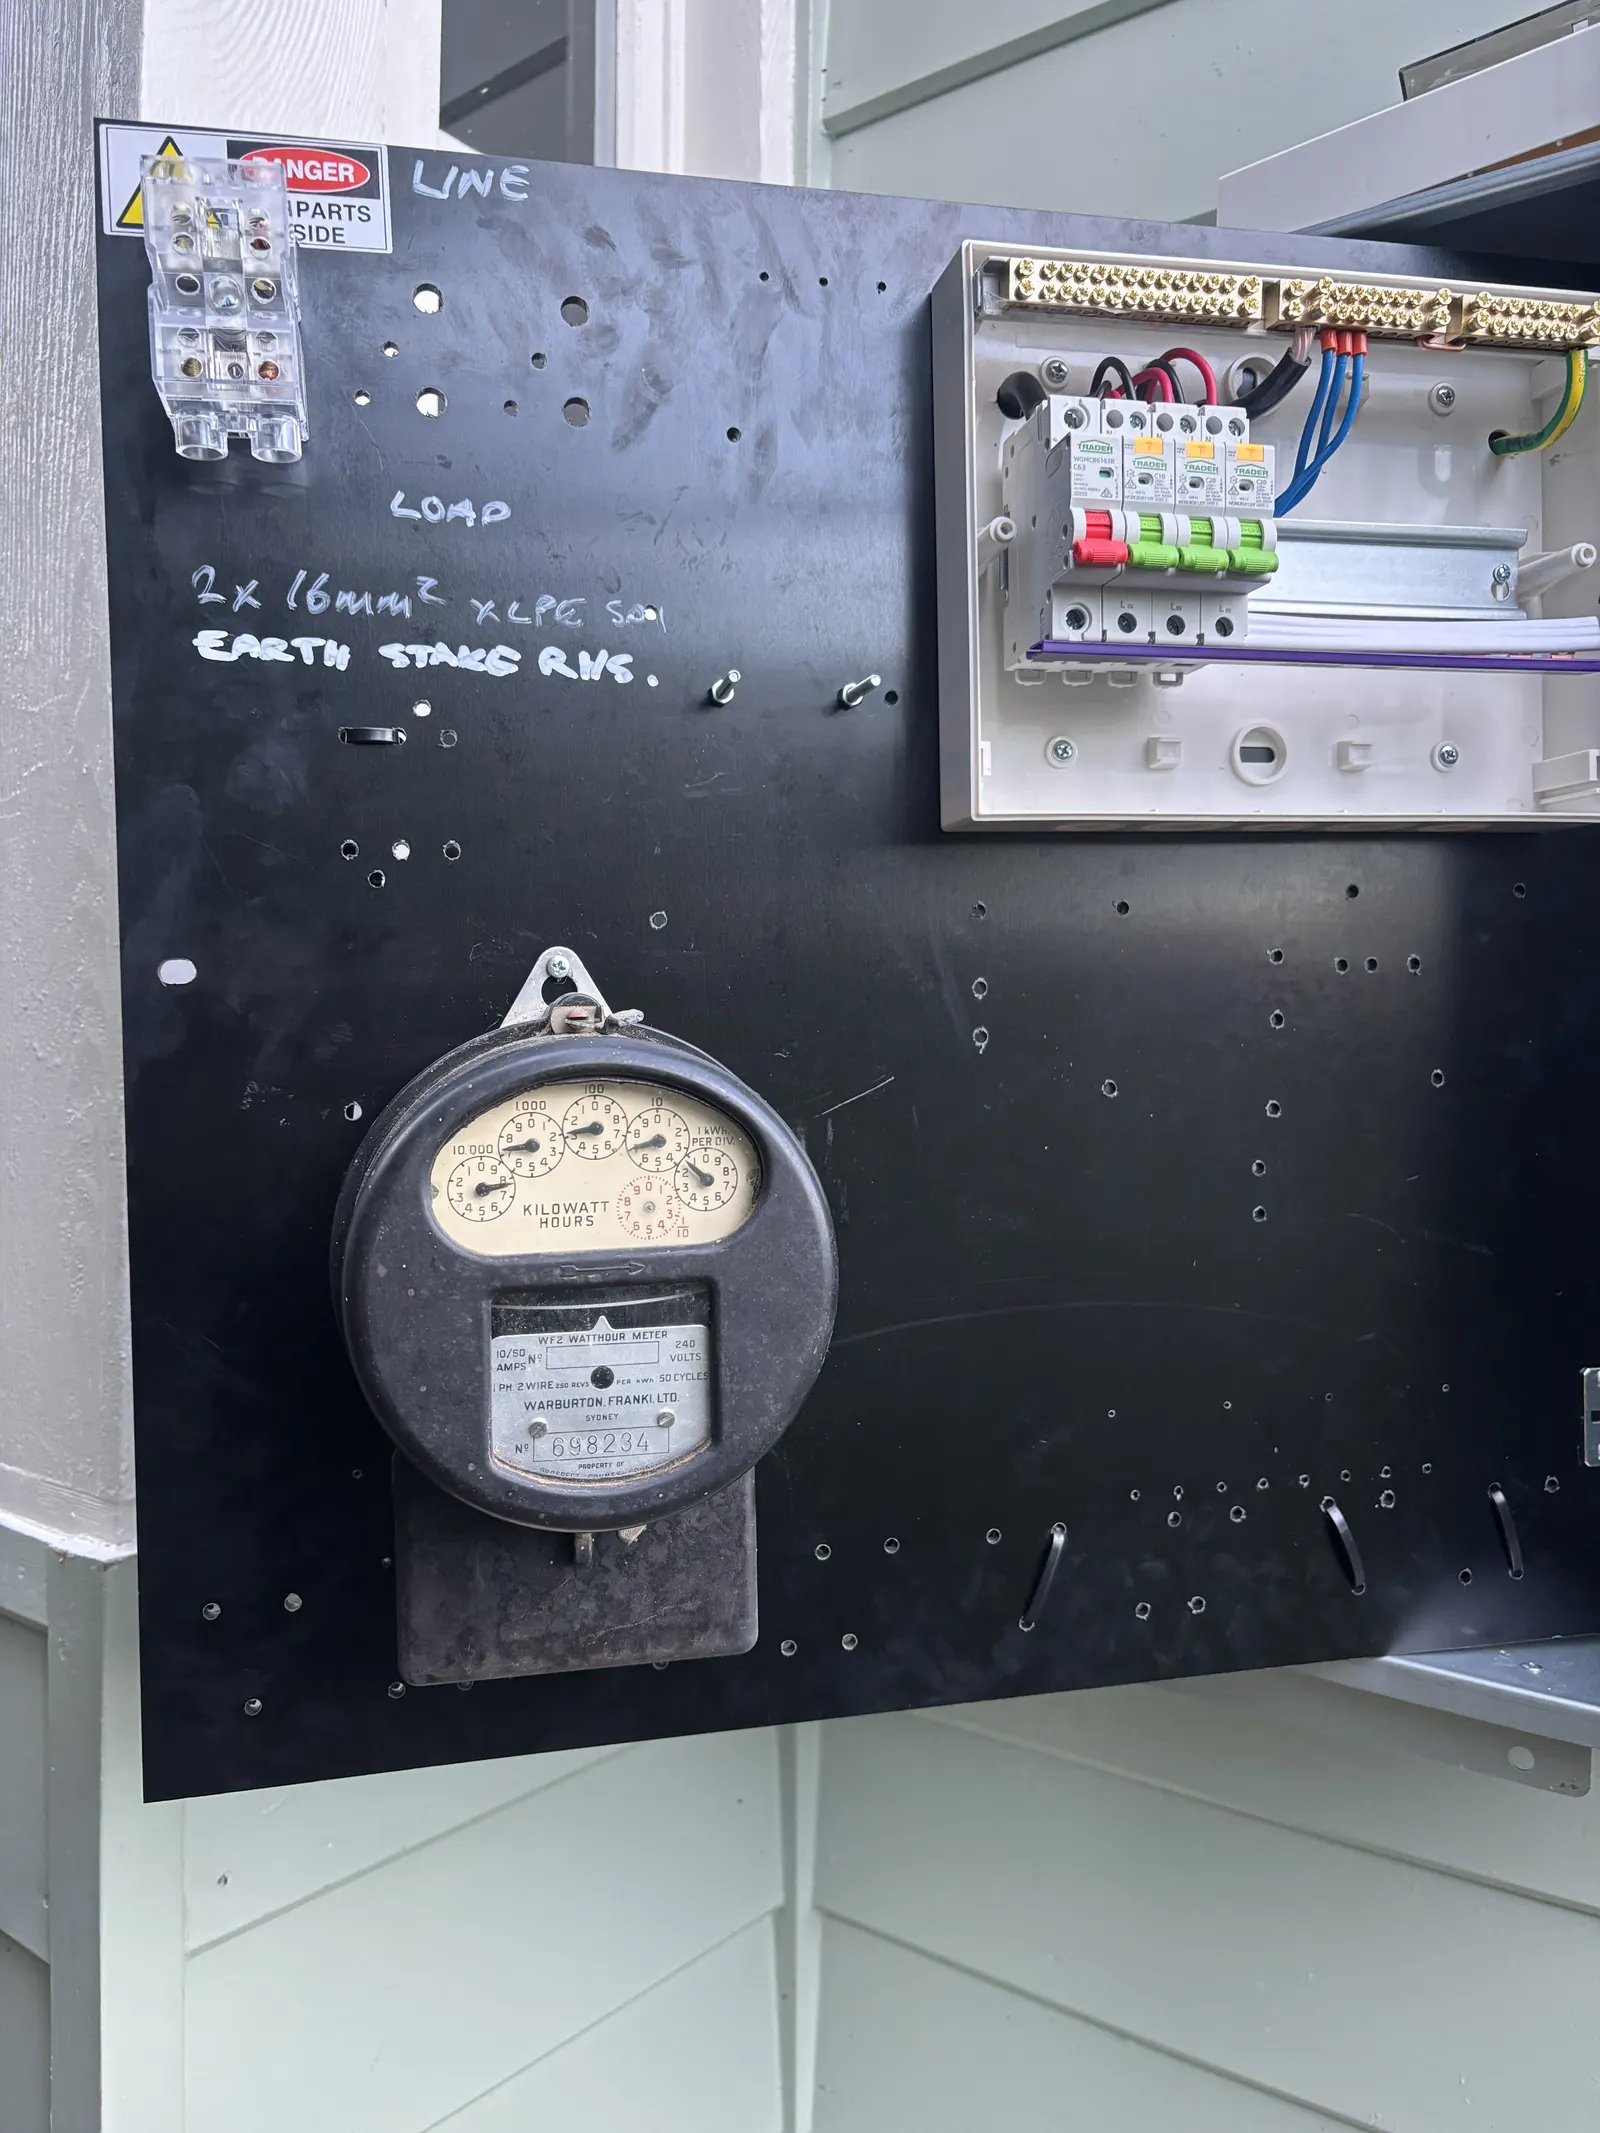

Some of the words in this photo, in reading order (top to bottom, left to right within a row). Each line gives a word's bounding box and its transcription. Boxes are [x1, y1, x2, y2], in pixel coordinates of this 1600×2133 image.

[252, 157, 355, 184] NGER
[412, 159, 530, 201] LINE
[296, 201, 371, 222] PARTS
[293, 223, 346, 244] SIDE
[1077, 443, 1113, 453] TRADER
[1073, 463, 1086, 471] C63
[1132, 460, 1167, 471] TRADER
[1184, 463, 1219, 474] TRADER
[1233, 467, 1268, 478] TRADER
[390, 490, 512, 528] LOAD
[191, 564, 227, 605] 2
[192, 629, 351, 671] EARTH
[379, 642, 521, 677] STAKE
[584, 1083, 605, 1094] 100
[592, 1101, 599, 1111] 0
[651, 1096, 663, 1107] 10
[605, 1104, 611, 1114] 9
[528, 1119, 535, 1129] 0
[571, 1115, 578, 1126] 2
[613, 1115, 620, 1125] 8
[643, 1118, 649, 1128] 9
[654, 1114, 661, 1124] 0
[516, 1122, 523, 1132] 9
[550, 1132, 557, 1142] 2
[614, 1128, 621, 1139] 7
[634, 1128, 641, 1138] 8
[676, 1128, 682, 1137] 2
[506, 1133, 513, 1143] 8
[692, 1137, 712, 1147] PER
[579, 1141, 587, 1151] 4
[592, 1145, 599, 1154] 5
[605, 1141, 612, 1151] 6
[676, 1142, 682, 1152] 3
[550, 1147, 557, 1157] 3
[540, 1157, 548, 1167] 4
[642, 1153, 649, 1163] 6
[655, 1157, 662, 1167] 5
[666, 1152, 674, 1163] 4
[703, 1153, 710, 1163] 0
[715, 1157, 722, 1166] 9
[477, 1161, 485, 1172] 0
[516, 1158, 523, 1168] 6
[529, 1162, 536, 1172] 5
[491, 1164, 498, 1175] 9
[683, 1168, 689, 1178] 2
[723, 1167, 730, 1177] 8
[456, 1177, 464, 1188] 2
[646, 1181, 653, 1192] 0
[724, 1181, 730, 1190] 7
[634, 1185, 641, 1196] 9
[683, 1183, 689, 1193] 3
[457, 1193, 464, 1203] 3
[499, 1191, 507, 1201] 7
[666, 1195, 673, 1205] 2
[690, 1192, 698, 1203] 4
[703, 1196, 710, 1206] 5
[715, 1191, 722, 1201] 6
[491, 1201, 498, 1212] 6
[624, 1196, 631, 1207] 8
[465, 1203, 473, 1213] 4
[479, 1206, 486, 1216] 5
[523, 1201, 609, 1216] KILOWATT
[625, 1210, 631, 1221] 7
[667, 1209, 673, 1219] 3
[539, 1216, 594, 1229] HOURS
[634, 1221, 640, 1231] 6
[658, 1219, 666, 1230] 4
[646, 1224, 653, 1235] 5
[538, 1335, 563, 1345] WF2
[568, 1332, 626, 1343] WATTHOUR
[632, 1330, 668, 1340] METER
[675, 1339, 696, 1349] 240
[669, 1352, 702, 1362] VOLTS
[496, 1361, 527, 1372] AMPS
[517, 1382, 524, 1391] 2
[525, 1381, 554, 1390] WIRE
[659, 1373, 671, 1383] 50
[673, 1371, 709, 1382] CYCLES
[657, 1392, 680, 1403] LTD.
[585, 1413, 619, 1421] SYDNEY
[552, 1432, 649, 1457] 698234
[578, 1461, 613, 1470] PROPERTY
